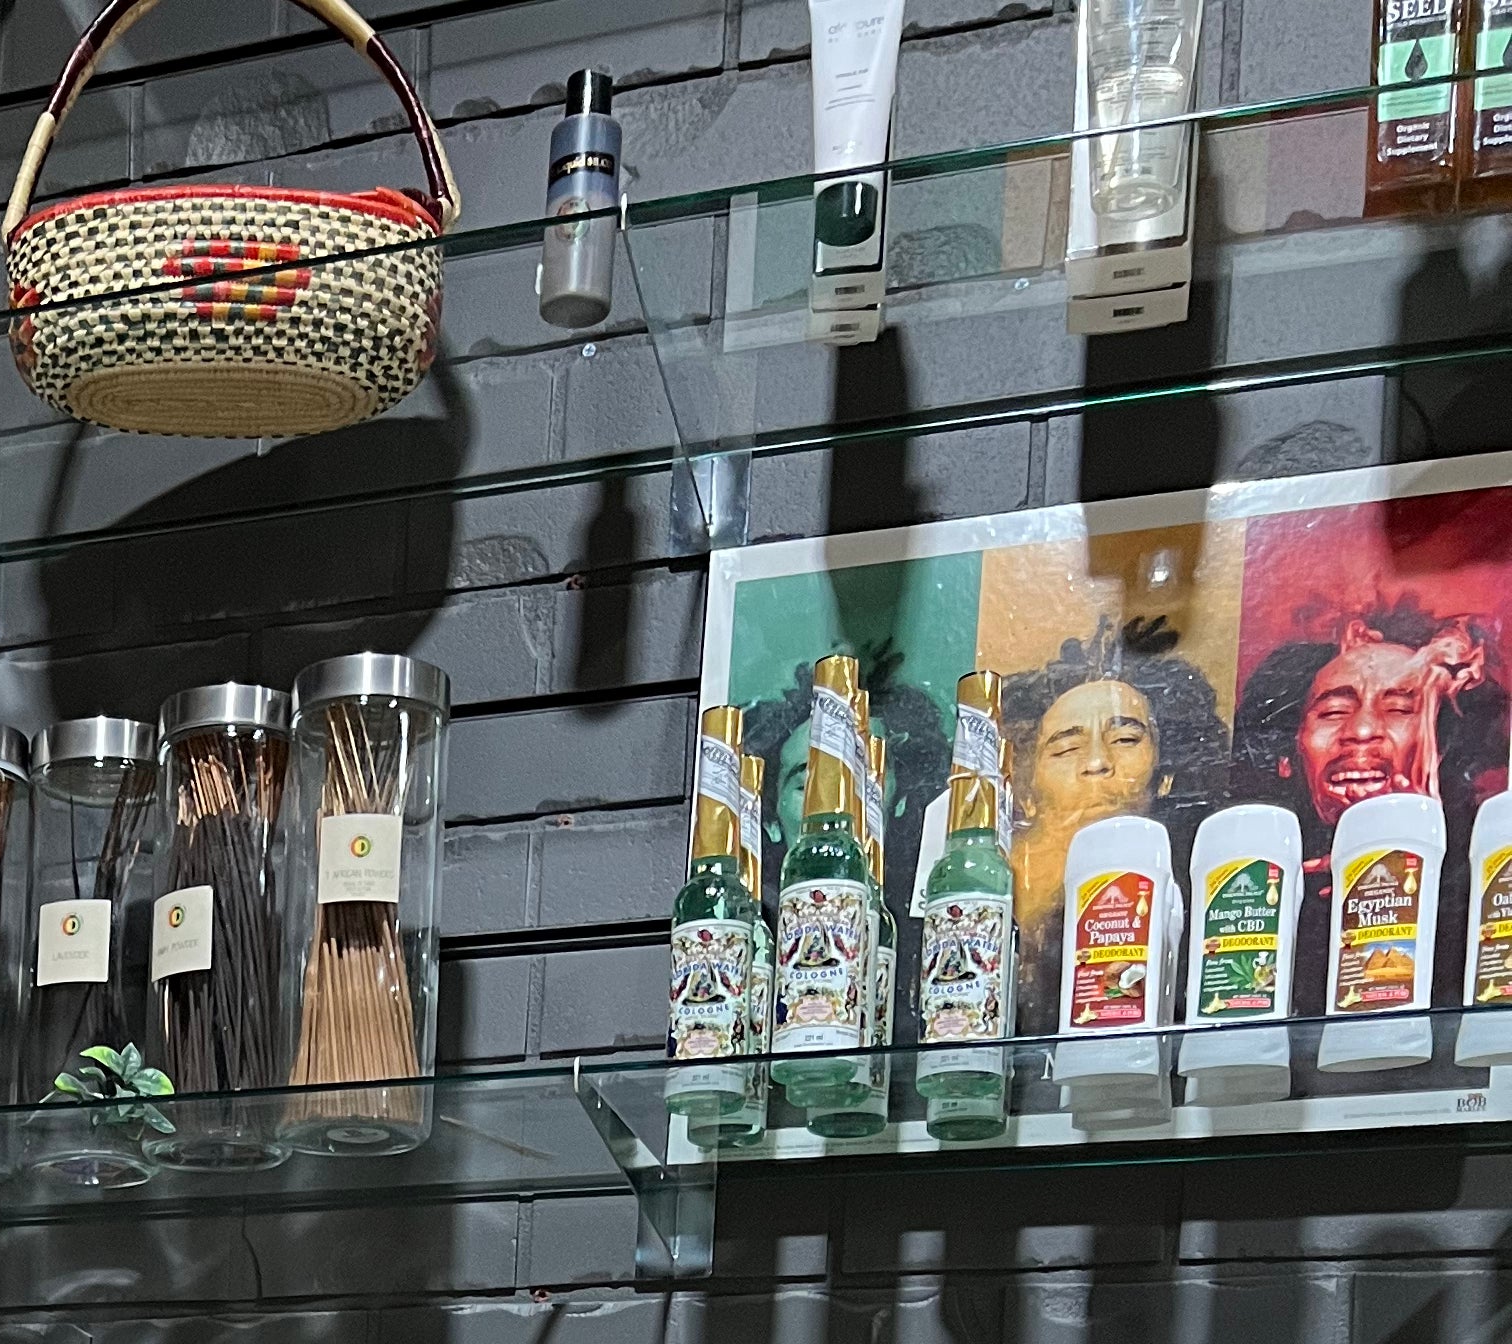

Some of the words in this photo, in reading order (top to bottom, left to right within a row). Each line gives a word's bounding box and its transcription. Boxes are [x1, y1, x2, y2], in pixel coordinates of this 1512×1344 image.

[1396, 122, 1430, 133] Organic
[1396, 133, 1429, 144] Dietary
[1386, 143, 1438, 156] Supplement
[1347, 893, 1413, 914] Egyptian
[1208, 909, 1243, 922] Mango
[1243, 906, 1277, 918] Butter
[1357, 911, 1399, 928] Musk
[1084, 917, 1130, 933] Coconut
[1131, 916, 1142, 930] &
[1237, 919, 1265, 933] CBD
[1089, 931, 1136, 947] Papaya
[1357, 926, 1413, 941] DEODORANT
[1222, 936, 1275, 949] DEODORANT
[1092, 947, 1145, 960] DEODORANT
[789, 968, 844, 981] COLOGNE
[928, 980, 981, 995] COLOGNE
[678, 1003, 730, 1016] COLOGNE
